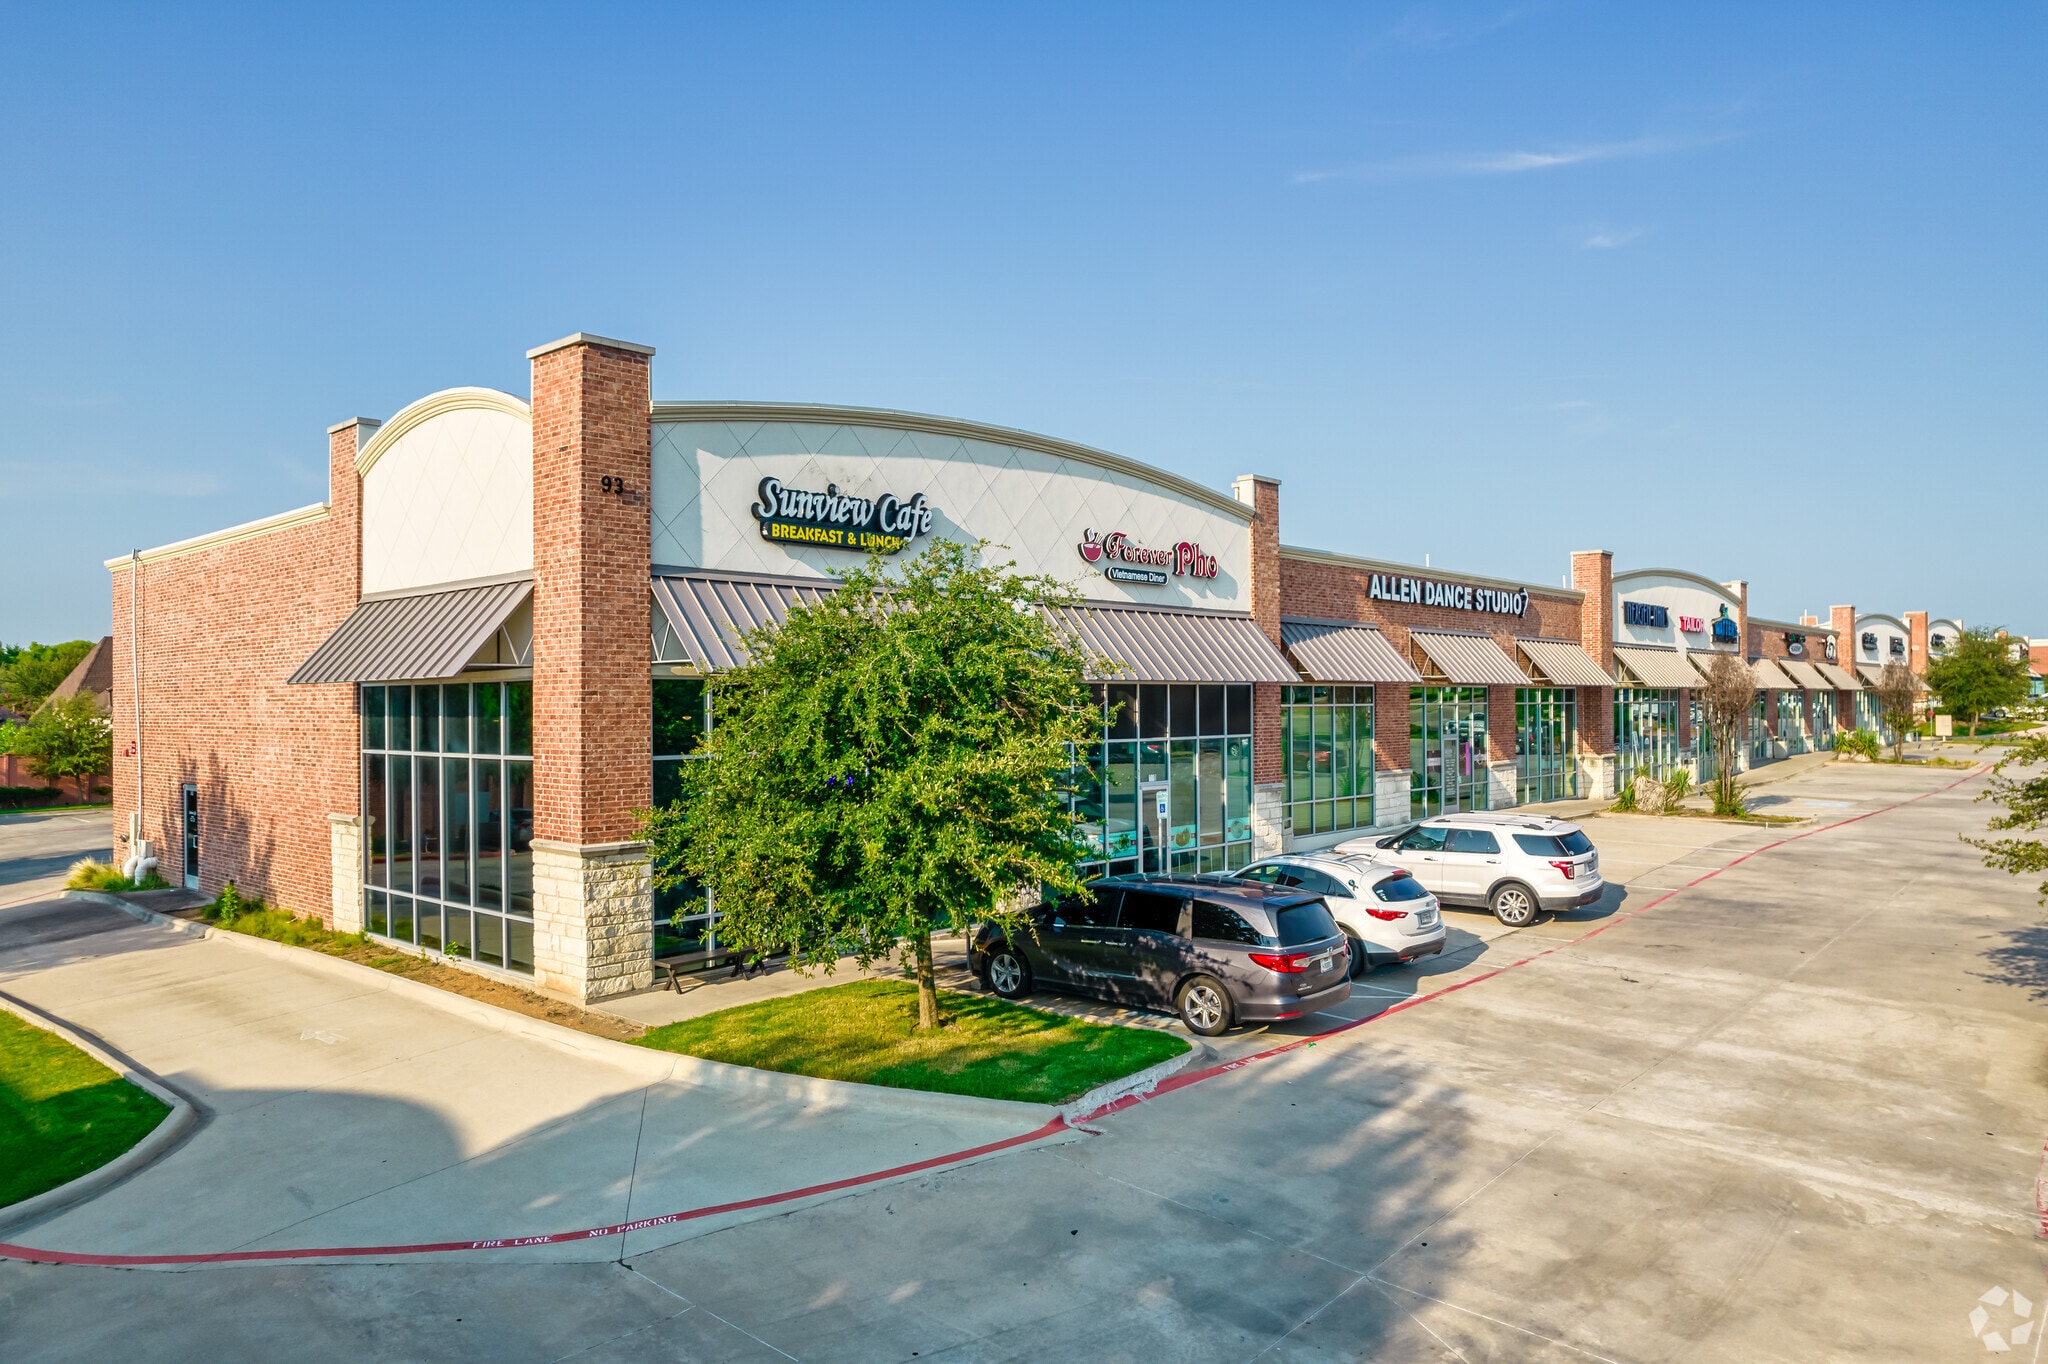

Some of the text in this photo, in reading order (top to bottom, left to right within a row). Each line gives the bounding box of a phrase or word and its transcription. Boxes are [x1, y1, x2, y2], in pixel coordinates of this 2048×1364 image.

[601, 475, 623, 494] 93
[757, 479, 933, 544] Sunview Cafe
[771, 523, 844, 544] BREAKFAST
[847, 532, 857, 545] &
[1105, 531, 1219, 578] Forever Pho
[1112, 568, 1166, 583] Vietnamese Diner
[1369, 574, 1522, 615] ALLEN DANCE STUDIO
[1681, 615, 1705, 633] TAILOR
[472, 1215, 677, 1249] FIRE LANE NO PARKING
